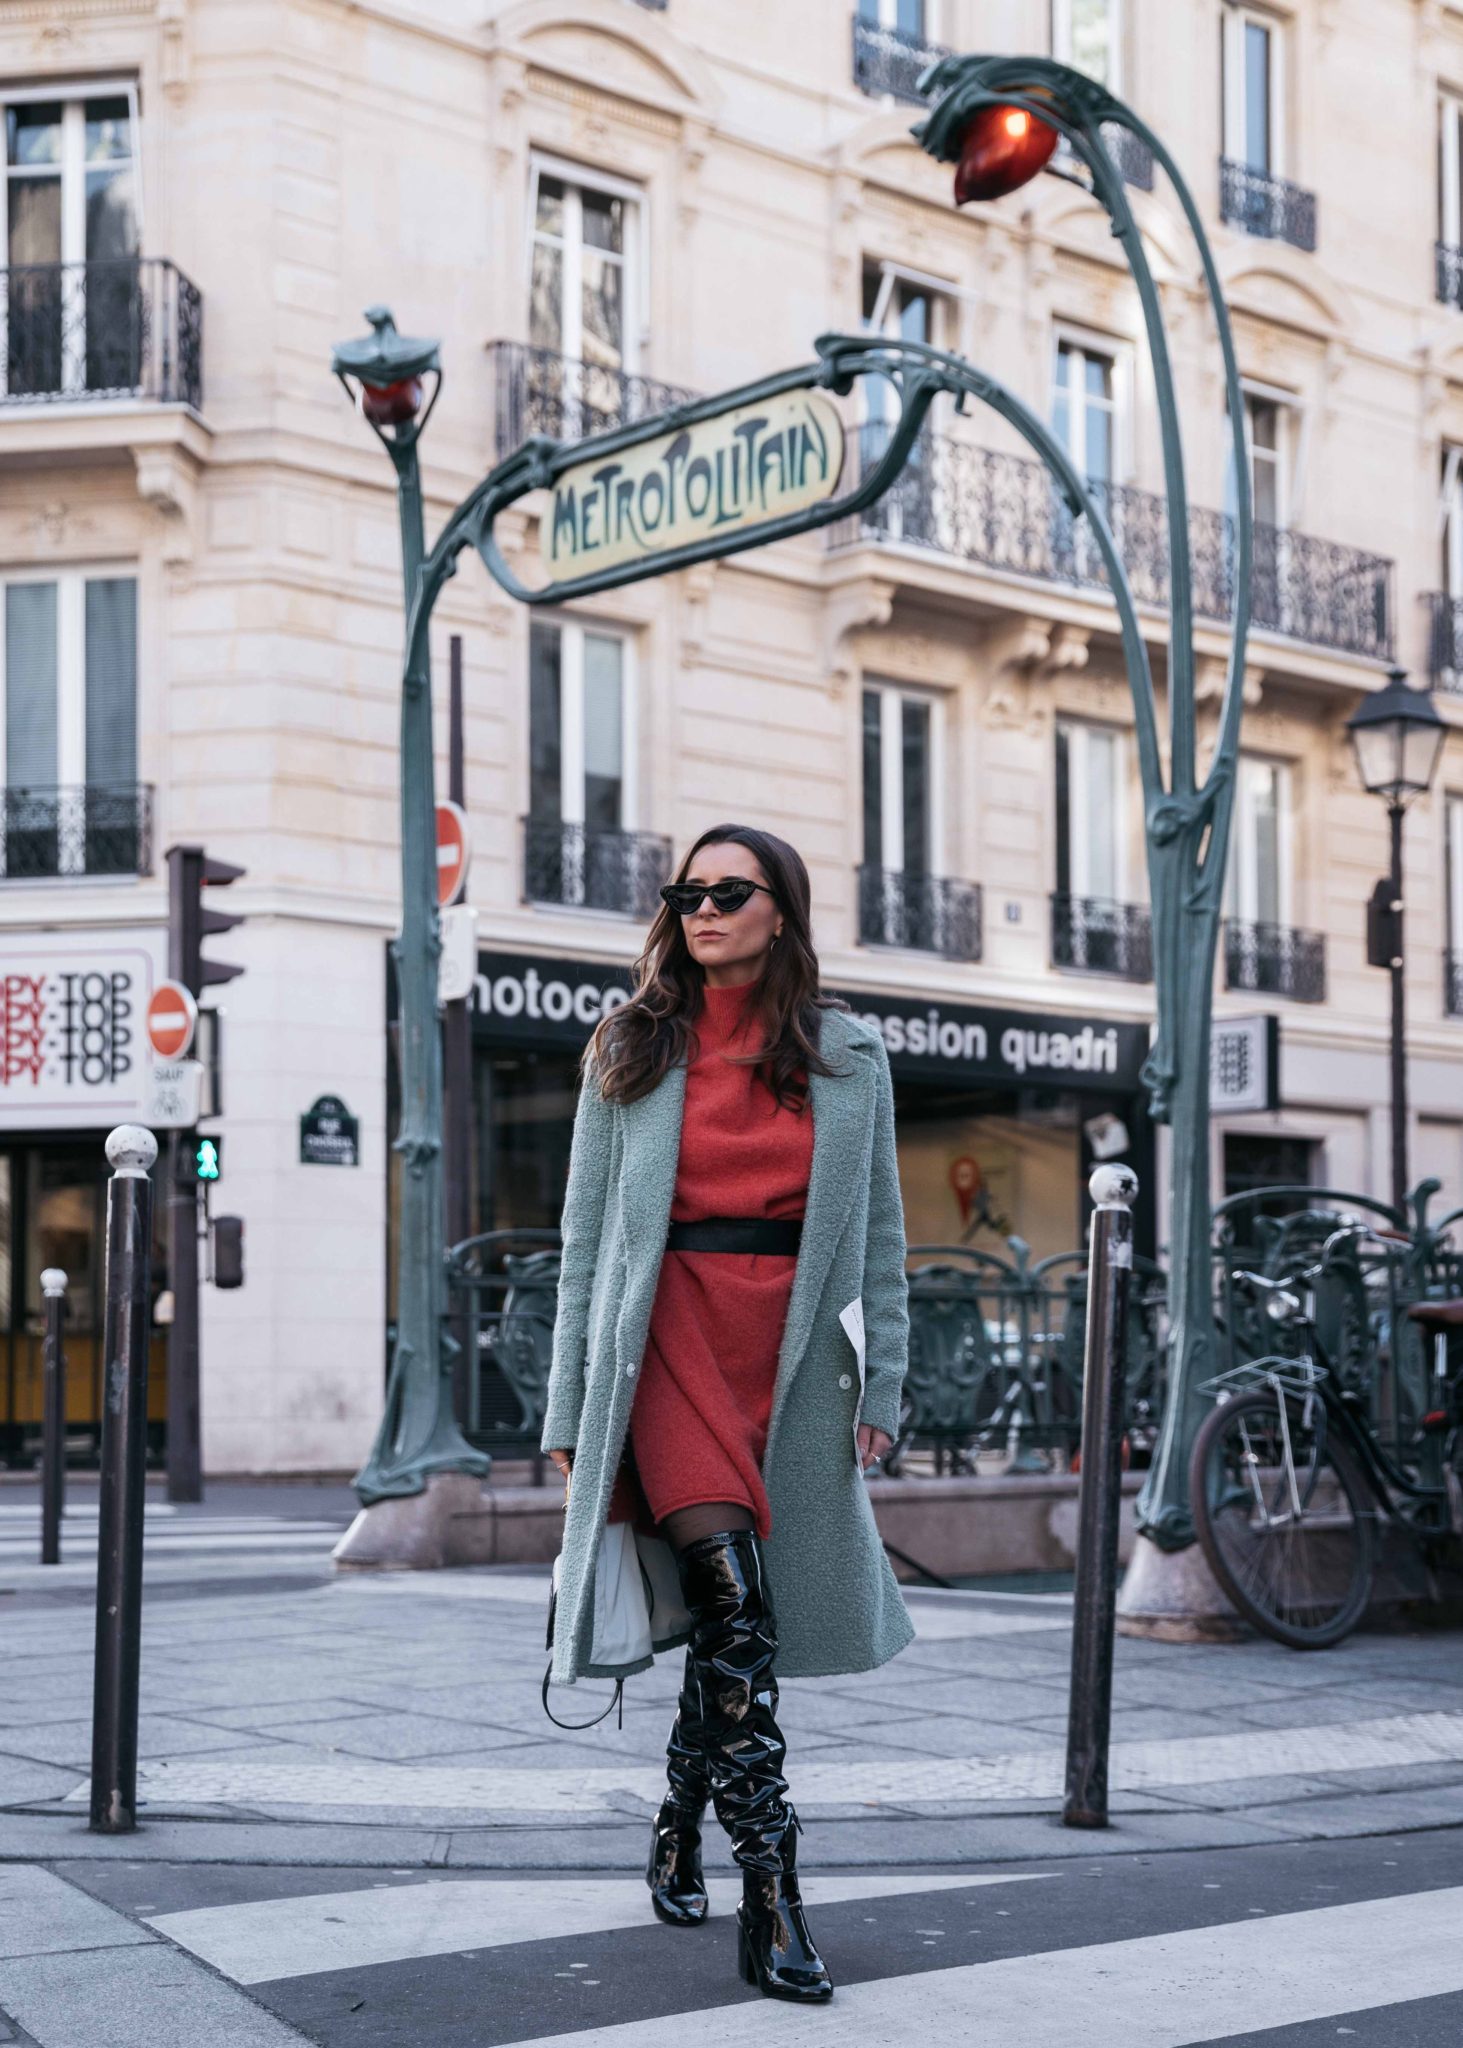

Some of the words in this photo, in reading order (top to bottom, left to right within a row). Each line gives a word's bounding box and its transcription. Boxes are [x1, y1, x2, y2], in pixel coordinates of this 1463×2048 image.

[552, 401, 828, 560] METROPOLITAIN
[0, 972, 131, 1003] PY-TOP
[0, 1000, 131, 1031] PY-TOP
[0, 1027, 131, 1058] PY-TOP
[1000, 1025, 1119, 1075] quadri
[0, 1054, 131, 1086] PY-TOP
